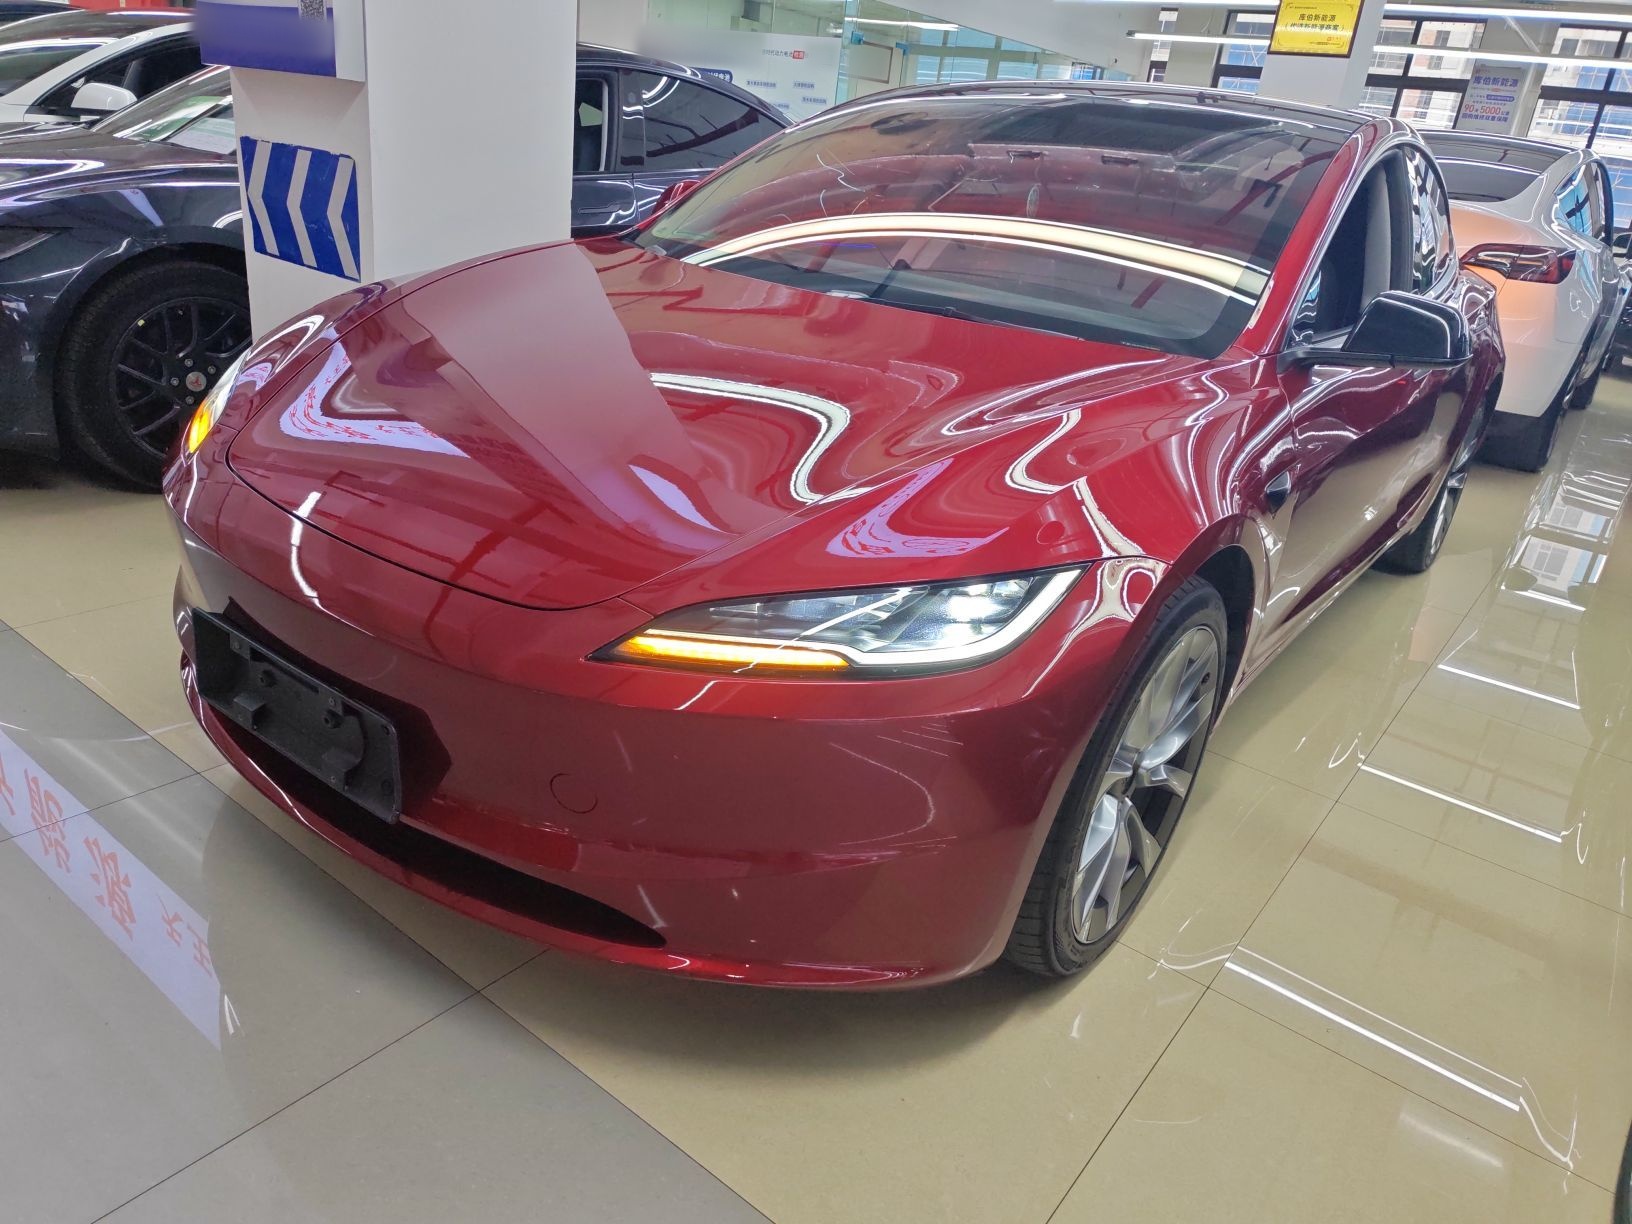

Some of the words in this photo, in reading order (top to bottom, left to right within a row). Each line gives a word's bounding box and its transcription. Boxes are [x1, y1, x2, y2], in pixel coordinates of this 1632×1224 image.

[1299, 13, 1337, 22] 库伯新能源
[1473, 76, 1519, 88] 库伯新能源
